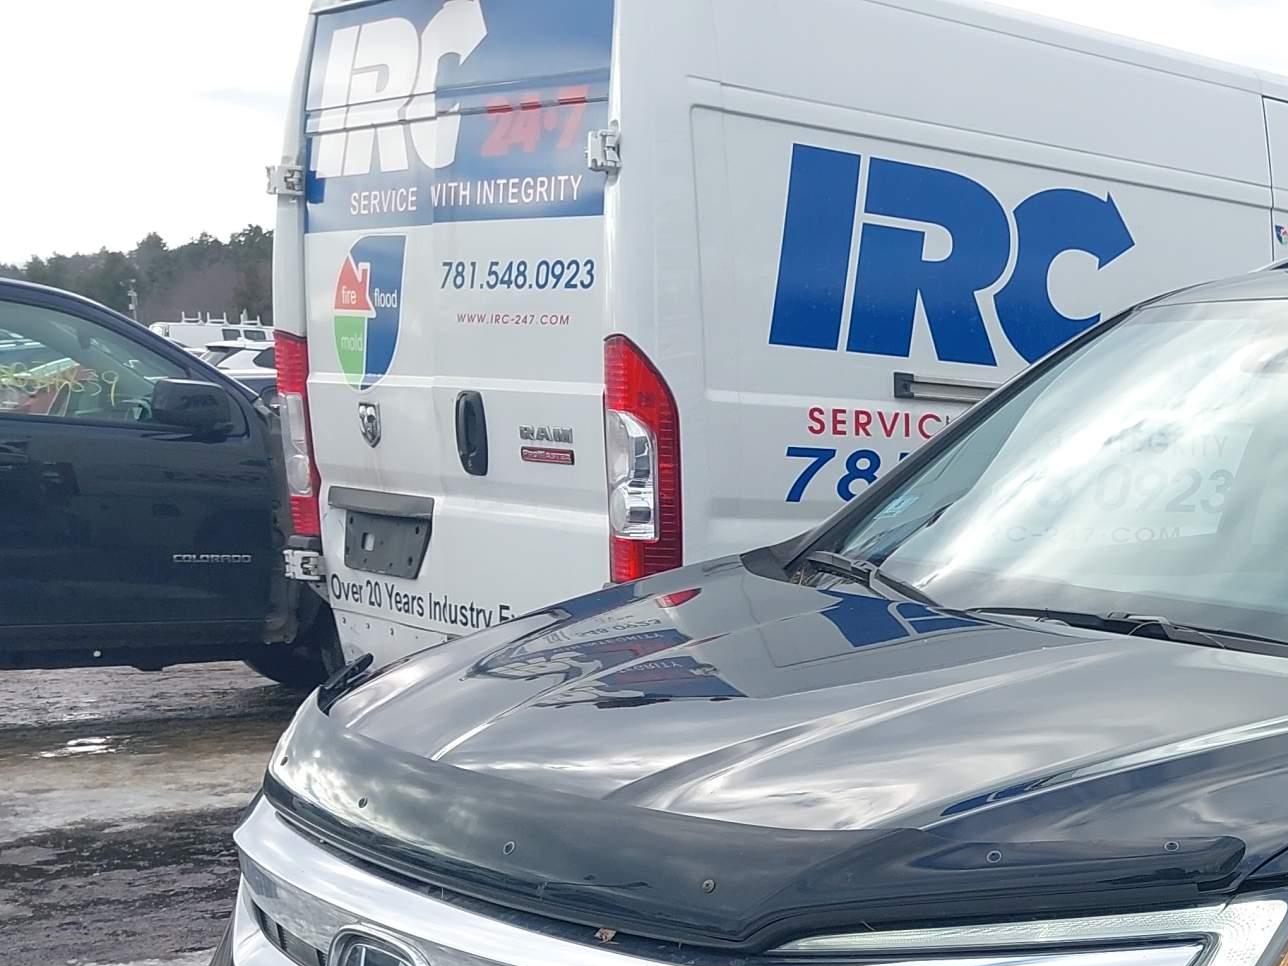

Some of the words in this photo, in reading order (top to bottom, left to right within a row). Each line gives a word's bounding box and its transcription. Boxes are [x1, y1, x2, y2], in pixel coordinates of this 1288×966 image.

[316, 0, 488, 179] IRC
[351, 186, 418, 216] SERVICE
[477, 175, 584, 204] INTEGRITY
[768, 143, 1135, 368] IRC
[440, 258, 595, 290] 781.548.0923
[341, 285, 357, 305] fire
[373, 287, 398, 308] flood
[456, 313, 570, 326] WWW.IRC-247.COM
[340, 332, 363, 352] mold
[519, 425, 574, 444] RAM
[807, 406, 952, 440] SERVIC
[173, 554, 253, 563] COLORADO
[330, 573, 364, 601] Over
[366, 579, 382, 608] 20
[384, 582, 425, 618] Years
[429, 592, 493, 629] Industry
